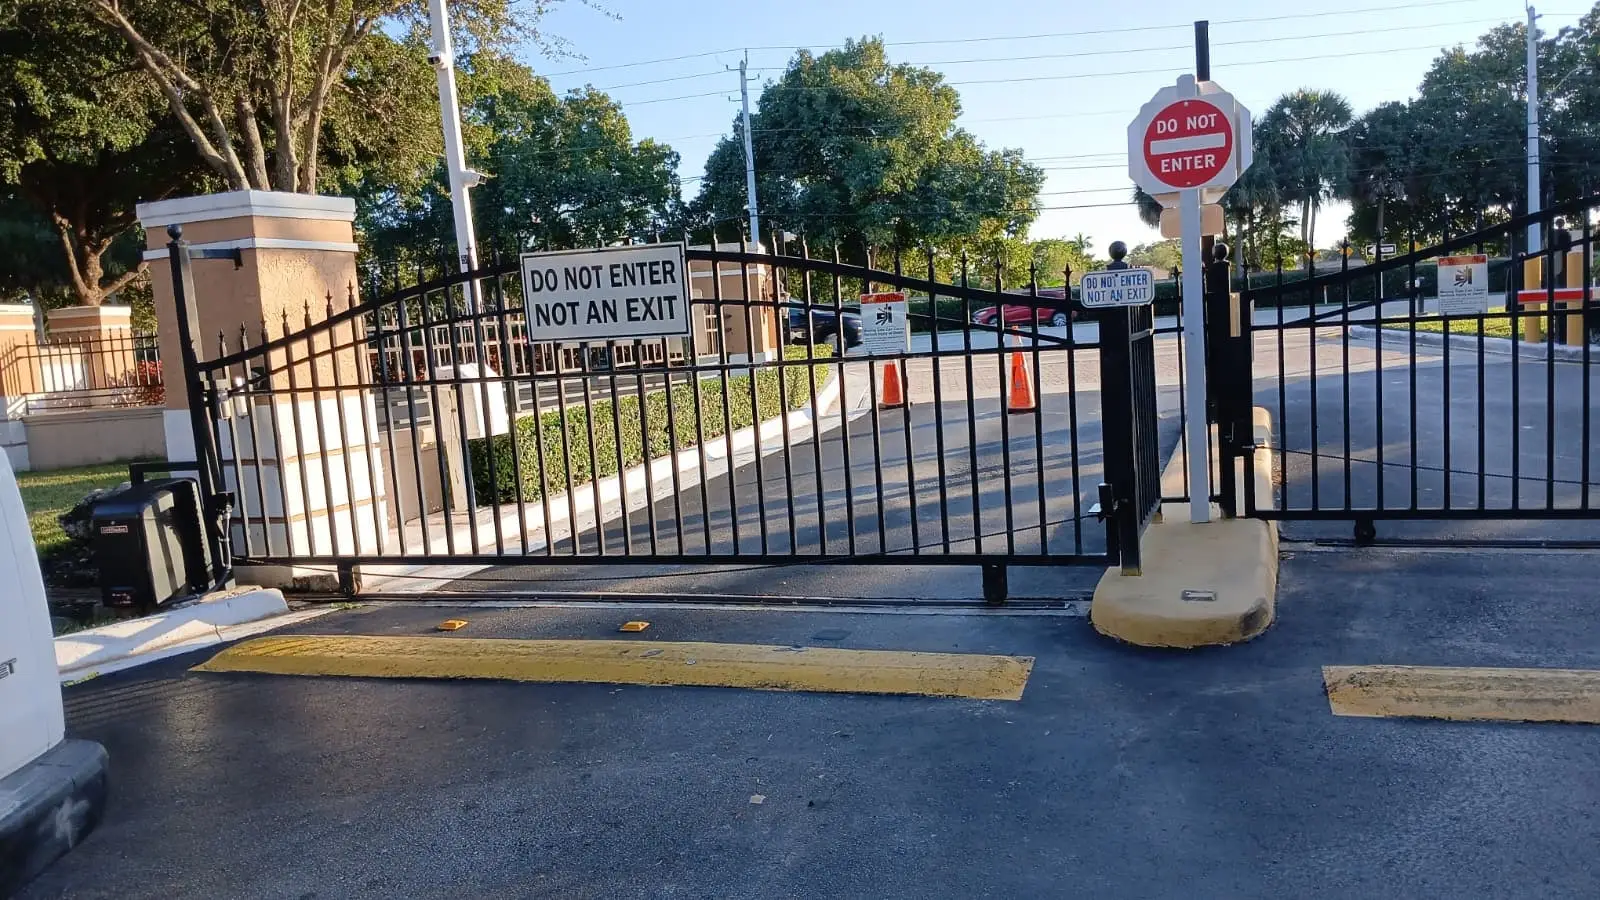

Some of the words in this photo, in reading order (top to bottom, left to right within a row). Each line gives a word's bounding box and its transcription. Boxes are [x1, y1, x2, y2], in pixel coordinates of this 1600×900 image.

[1157, 119, 1178, 134] DO
[1186, 113, 1217, 131] NOT
[1161, 154, 1216, 173] ENTER
[530, 268, 558, 293] DO
[564, 265, 603, 291] NOT
[609, 260, 677, 288] ENTER
[1086, 277, 1098, 289] DO
[1101, 276, 1117, 288] NOT
[1120, 273, 1148, 287] ENTER
[1087, 290, 1106, 303] NOT
[1110, 289, 1123, 301] AN
[1127, 287, 1147, 300] EXIT
[535, 302, 580, 327] NOT
[586, 299, 619, 325] AN
[625, 295, 678, 322] EXIT
